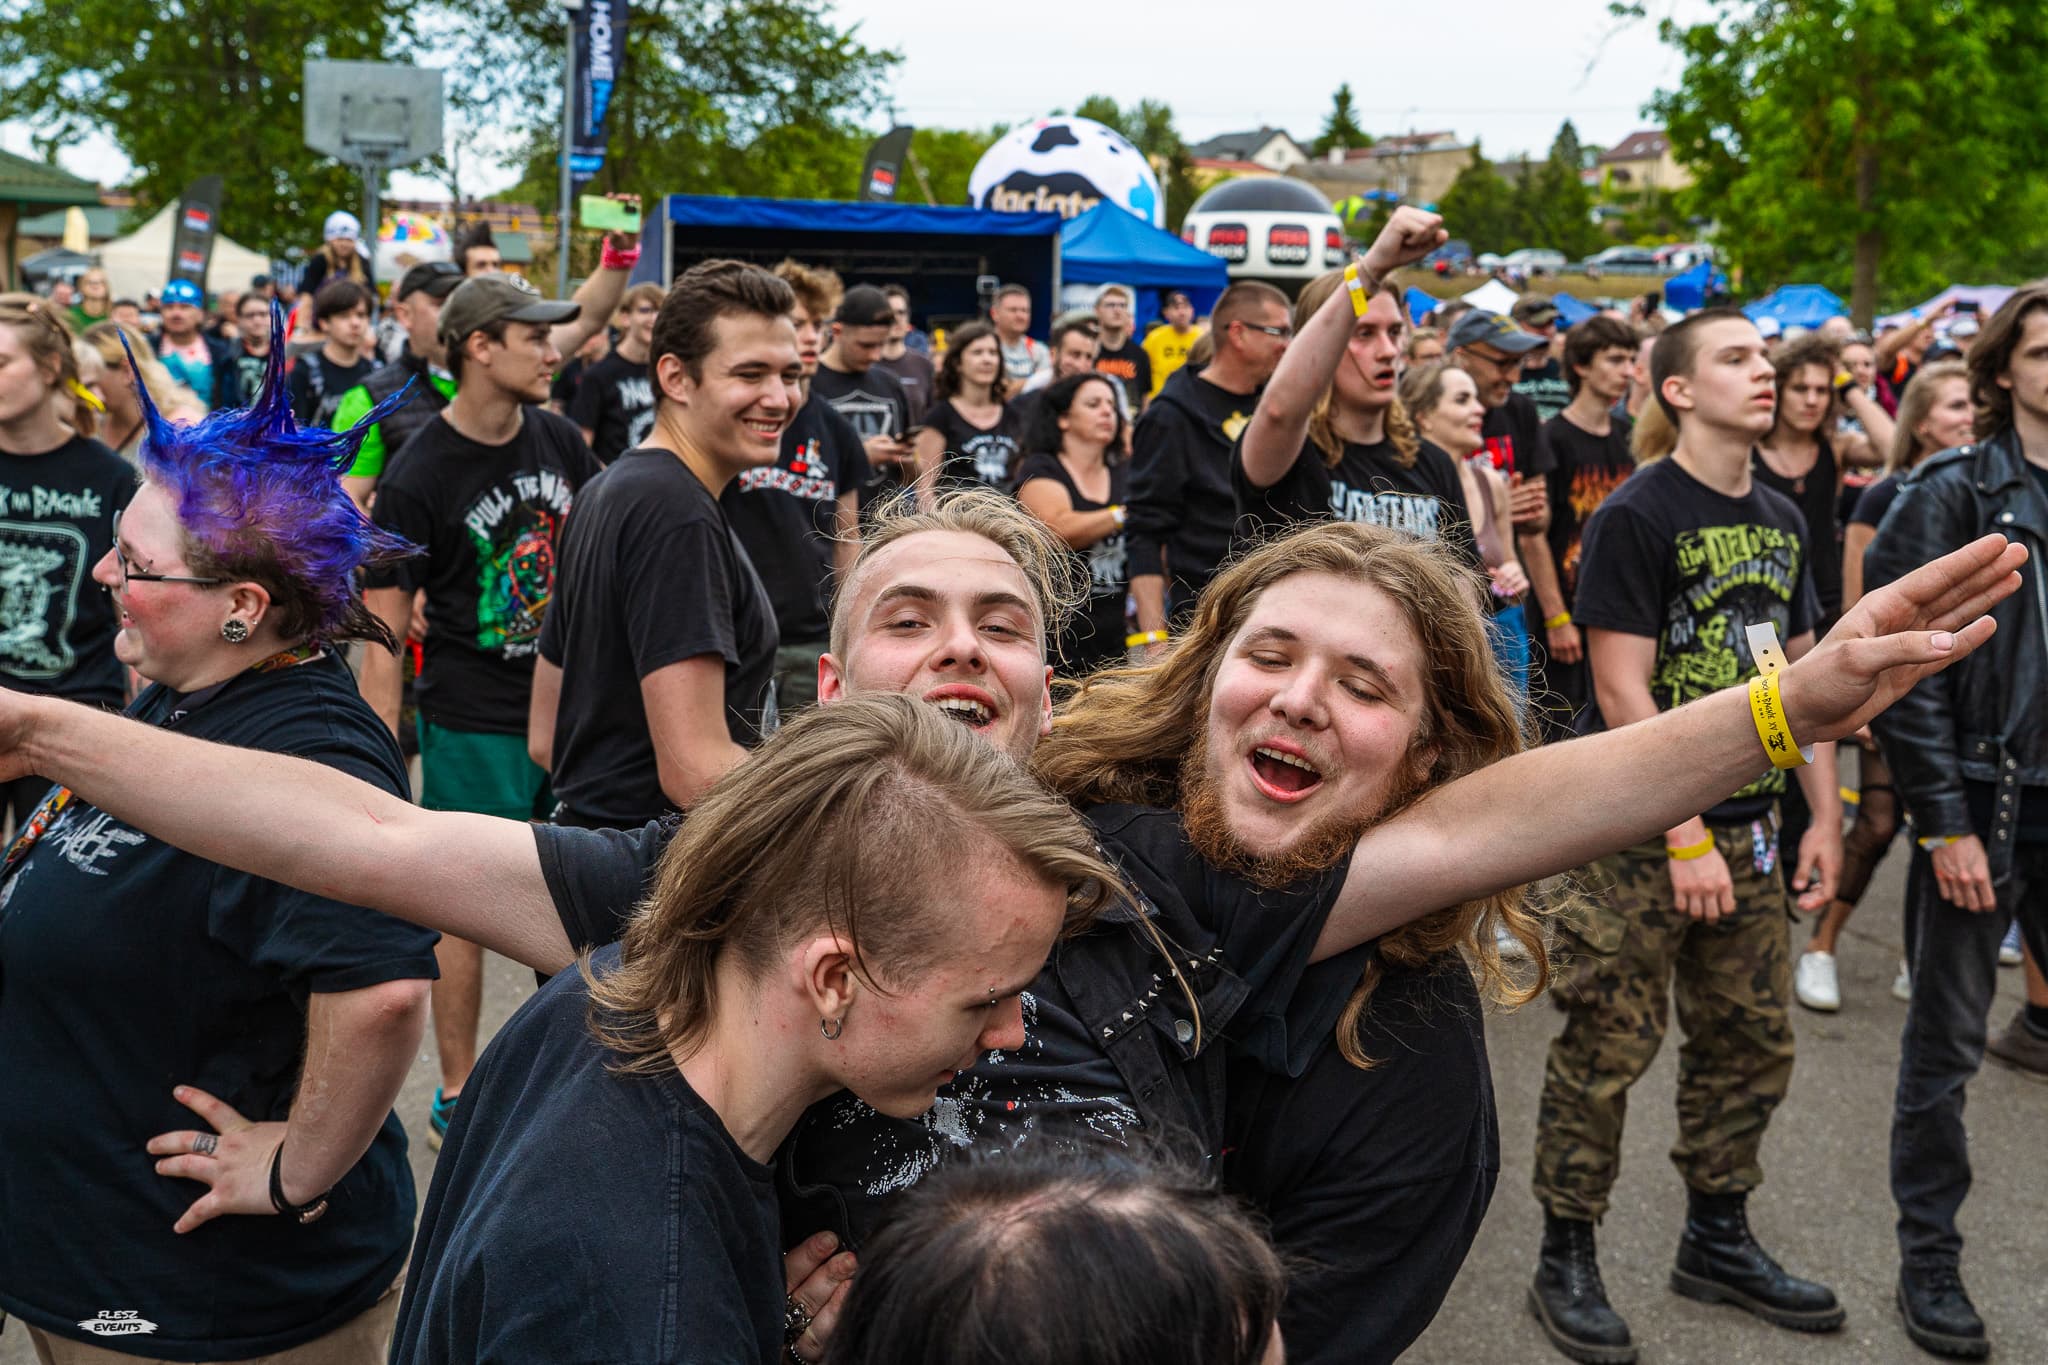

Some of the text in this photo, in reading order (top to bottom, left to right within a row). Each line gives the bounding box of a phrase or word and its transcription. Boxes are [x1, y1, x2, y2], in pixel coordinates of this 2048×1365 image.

[589, 1, 613, 80] HOME
[465, 486, 513, 541] PULL
[512, 474, 541, 502] THE
